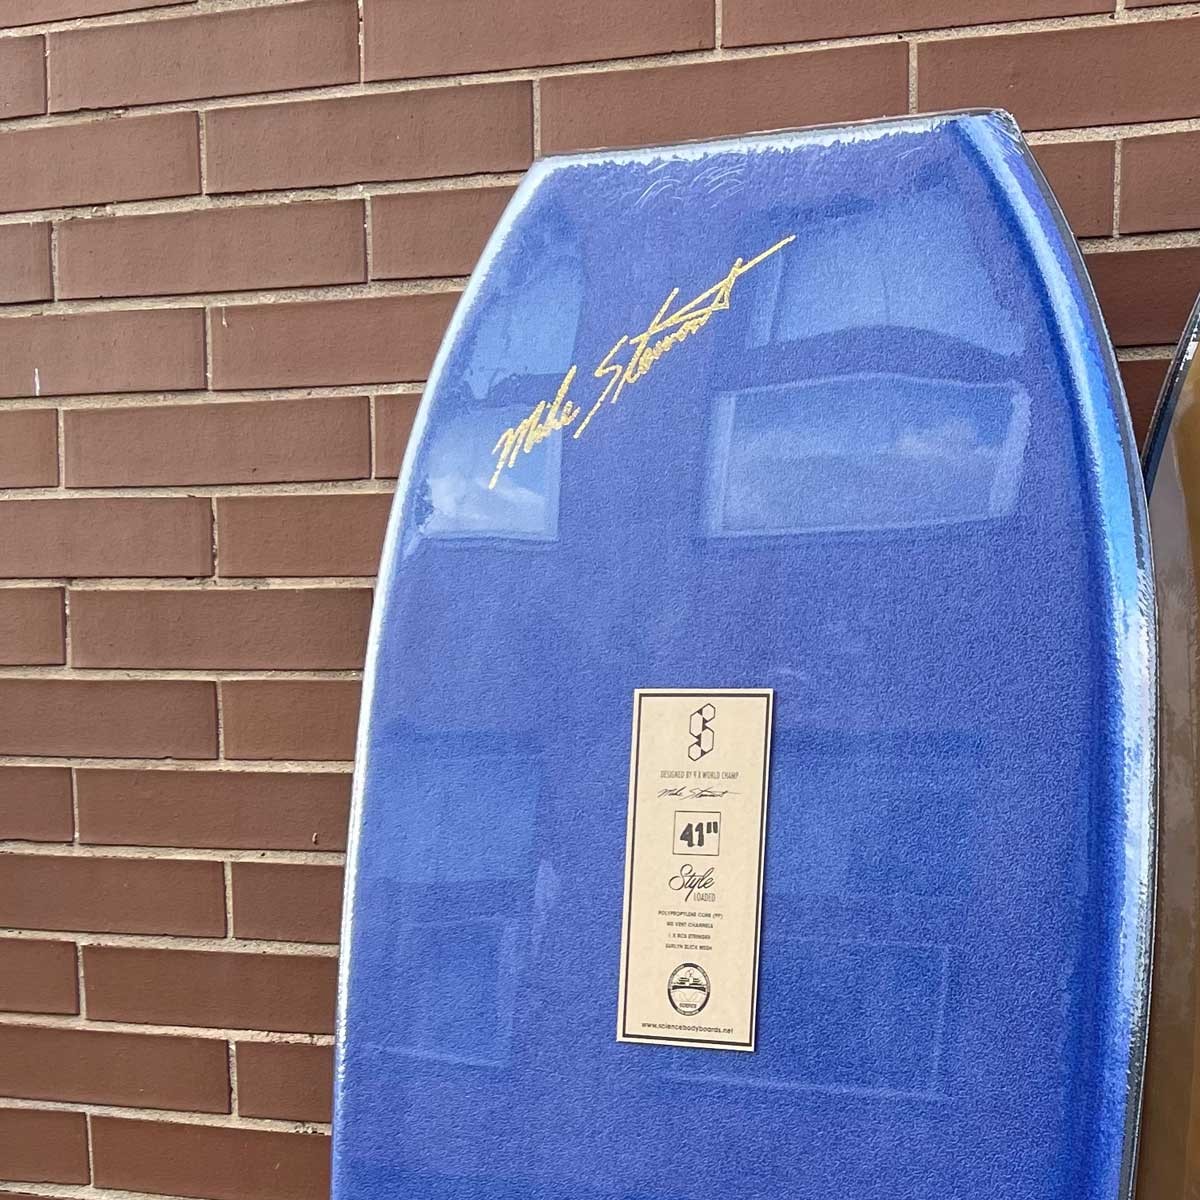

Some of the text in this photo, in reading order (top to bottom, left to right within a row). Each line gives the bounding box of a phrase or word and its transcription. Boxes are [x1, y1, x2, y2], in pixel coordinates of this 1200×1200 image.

[660, 770, 685, 779] DESIGNED
[686, 771, 692, 779] BY
[702, 771, 720, 779] WORLD
[721, 771, 739, 780] CHAMP
[679, 821, 718, 847] 41"
[668, 863, 715, 902] Style
